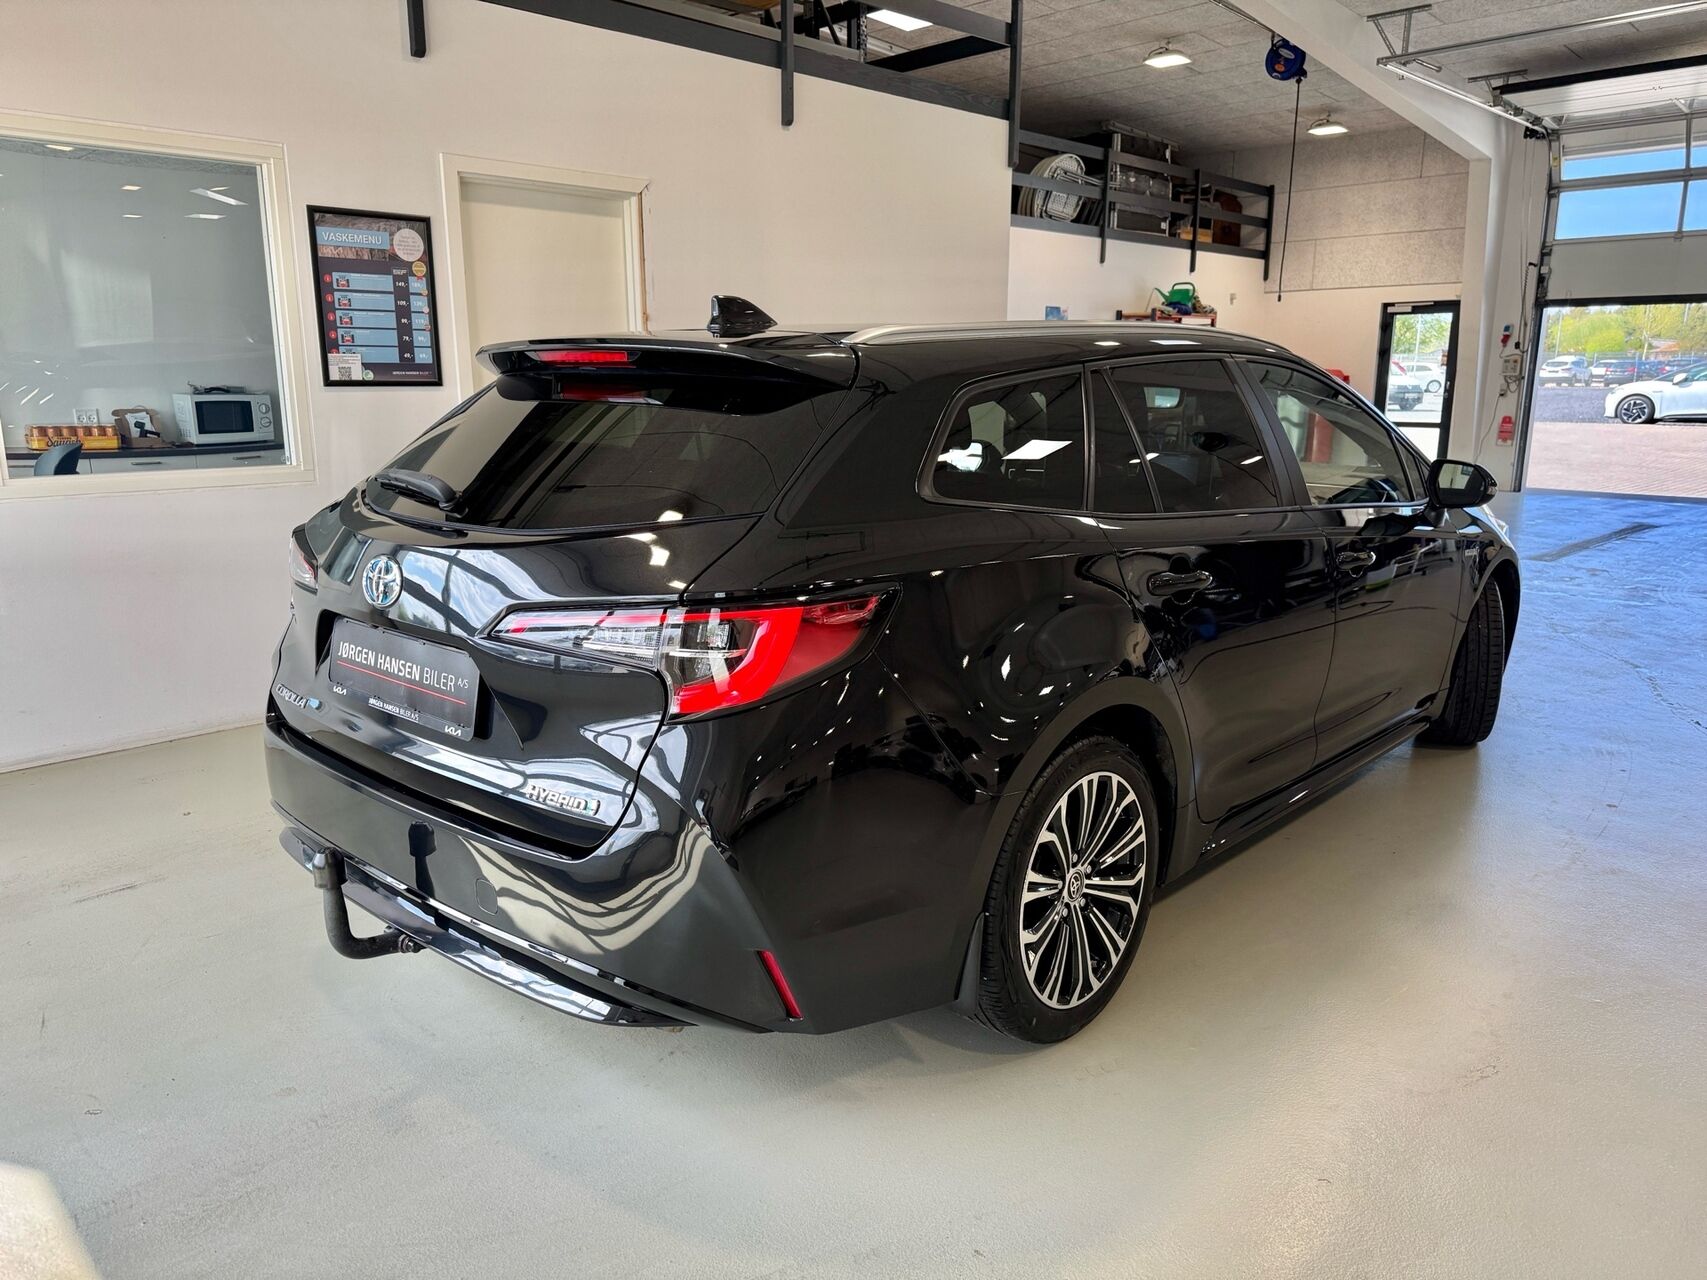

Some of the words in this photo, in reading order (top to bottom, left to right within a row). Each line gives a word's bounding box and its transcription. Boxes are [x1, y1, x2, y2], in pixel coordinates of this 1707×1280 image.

[322, 231, 382, 245] VASKEMENU
[338, 641, 375, 666] JØRGEN
[377, 653, 420, 681] HANSEN
[423, 667, 455, 692] BILER
[457, 678, 469, 689] A/S
[275, 683, 306, 709] COROLLA
[525, 784, 590, 812] HYBRID
